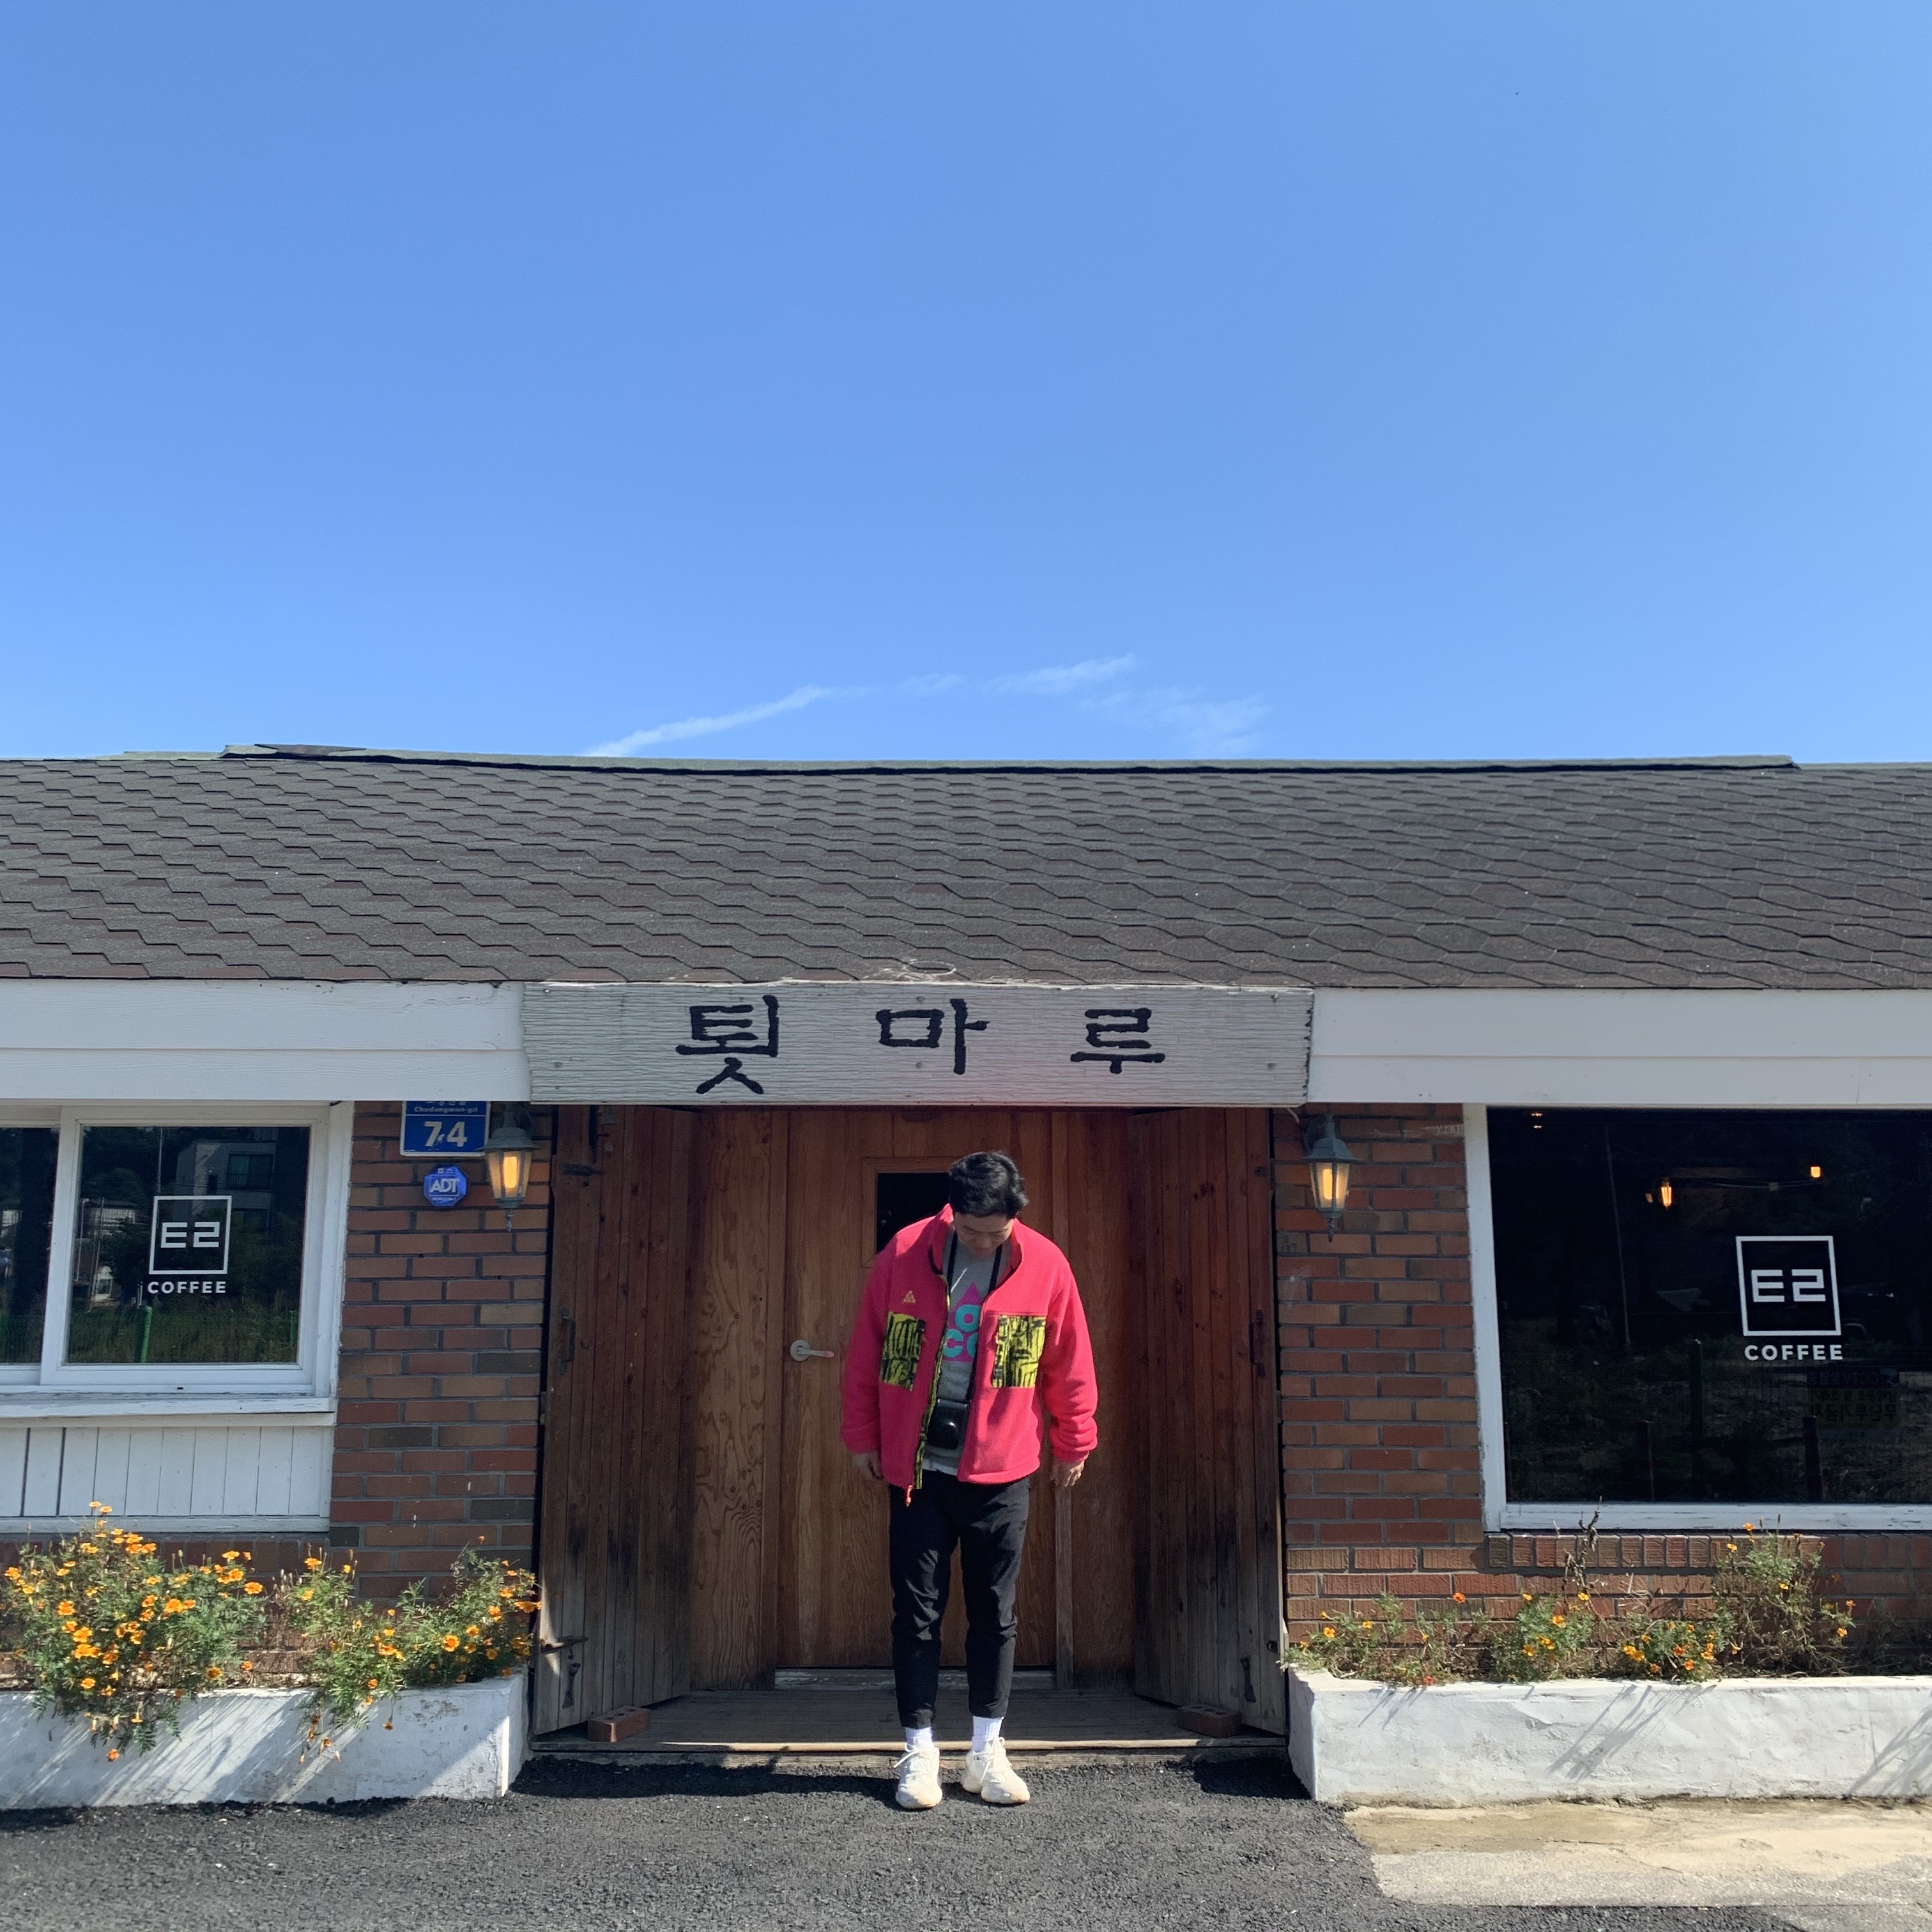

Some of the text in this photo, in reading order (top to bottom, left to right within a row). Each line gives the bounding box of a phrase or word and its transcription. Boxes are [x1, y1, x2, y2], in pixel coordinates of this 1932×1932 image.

[424, 1121, 467, 1147] 74
[429, 1178, 460, 1193] ADT
[160, 1222, 220, 1248] E2
[148, 1281, 226, 1294] COFFEE
[1751, 1269, 1826, 1302] E2
[1744, 1344, 1843, 1361] COFFEE
